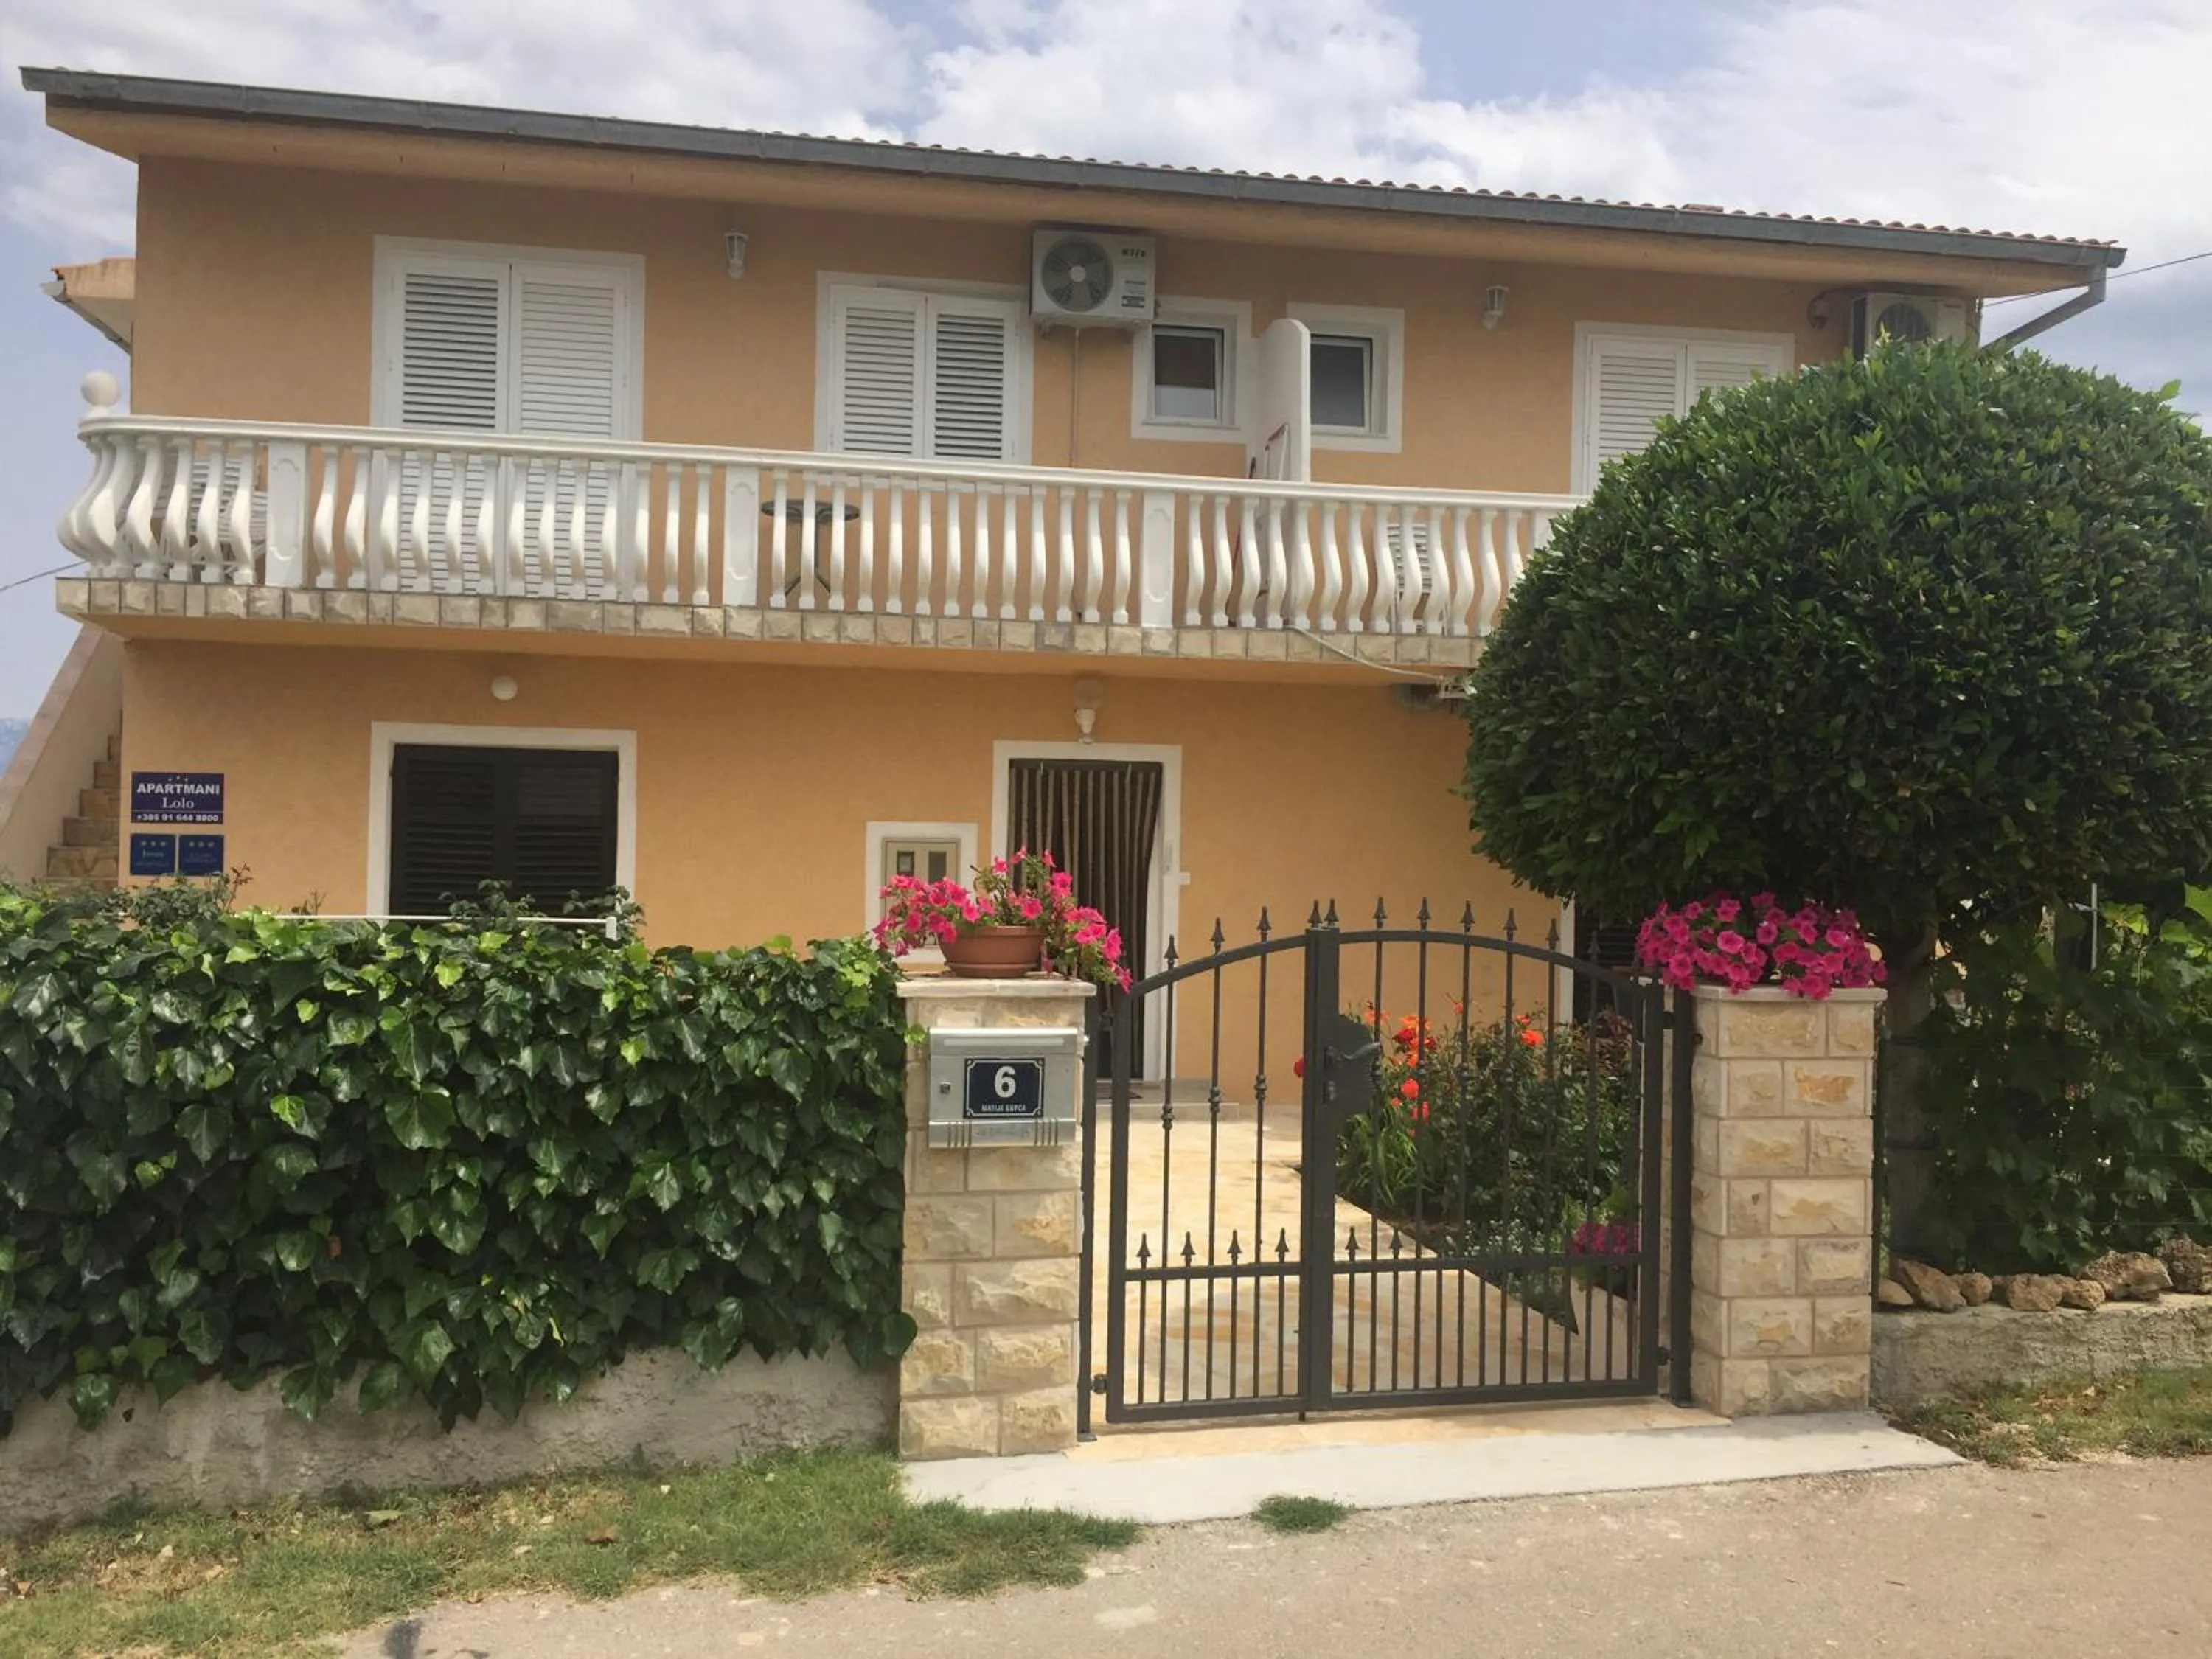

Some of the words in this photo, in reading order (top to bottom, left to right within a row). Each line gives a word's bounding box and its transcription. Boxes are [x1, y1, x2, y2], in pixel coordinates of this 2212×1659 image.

[136, 783, 220, 795] APARTMANI
[162, 797, 195, 809] Lolo
[995, 1065, 1016, 1098] 6
